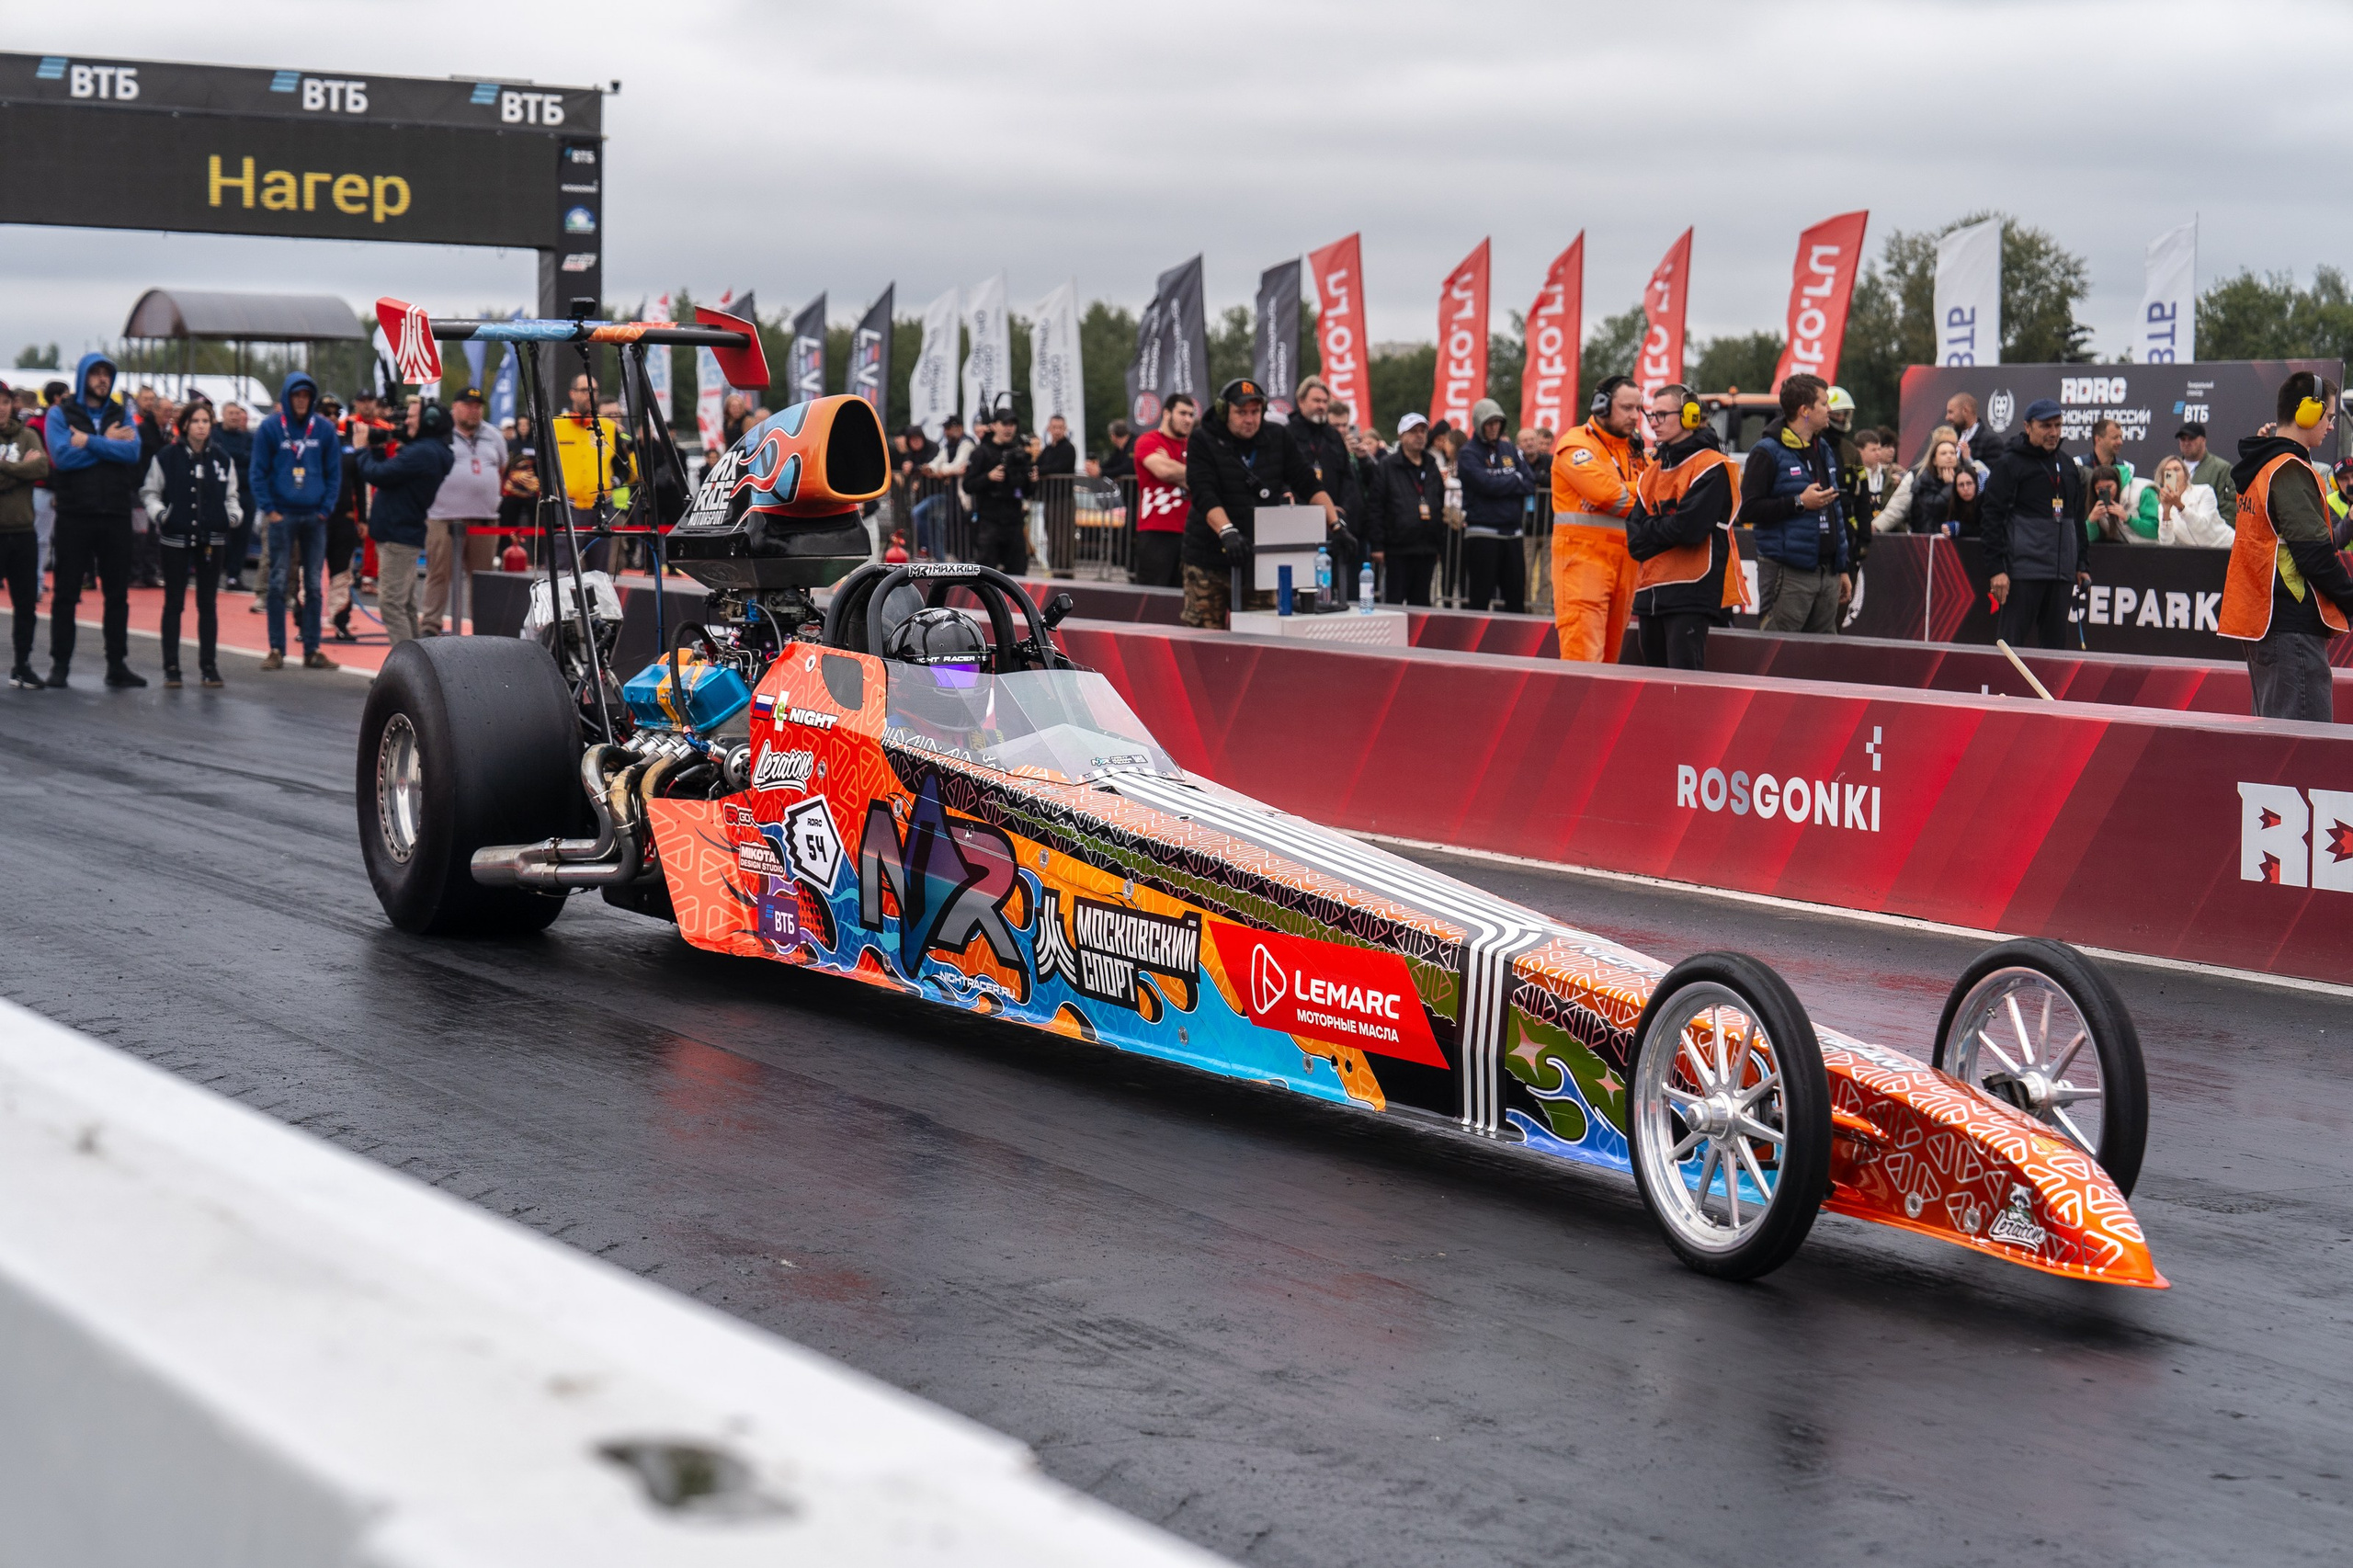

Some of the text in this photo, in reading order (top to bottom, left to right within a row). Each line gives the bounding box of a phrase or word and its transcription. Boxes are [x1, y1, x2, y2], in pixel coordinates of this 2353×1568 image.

[70, 64, 140, 100] ВТБ
[301, 79, 369, 114] ВТБ
[501, 92, 564, 125] ВТБ
[209, 155, 412, 223] Нагер
[2060, 376, 2128, 404] RDRC
[2183, 403, 2210, 424] ВТБ
[687, 510, 727, 527] MOTORSPORT
[789, 707, 840, 731] NIGHT
[1677, 763, 1881, 833] ROSGONKI
[806, 817, 823, 828] RDRC
[805, 834, 828, 863] 54
[740, 858, 784, 874] DESIGN STUDIO
[774, 910, 795, 936] ВТБ
[1075, 904, 1198, 974] МОСКОВСКИЙ
[938, 970, 1016, 999] NIGHTRACER.RU
[1080, 949, 1136, 1003] СПОРТ
[1294, 970, 1402, 1021] LEMARC
[1296, 1007, 1400, 1043] МОТОРНЫЕ МАСЛА
